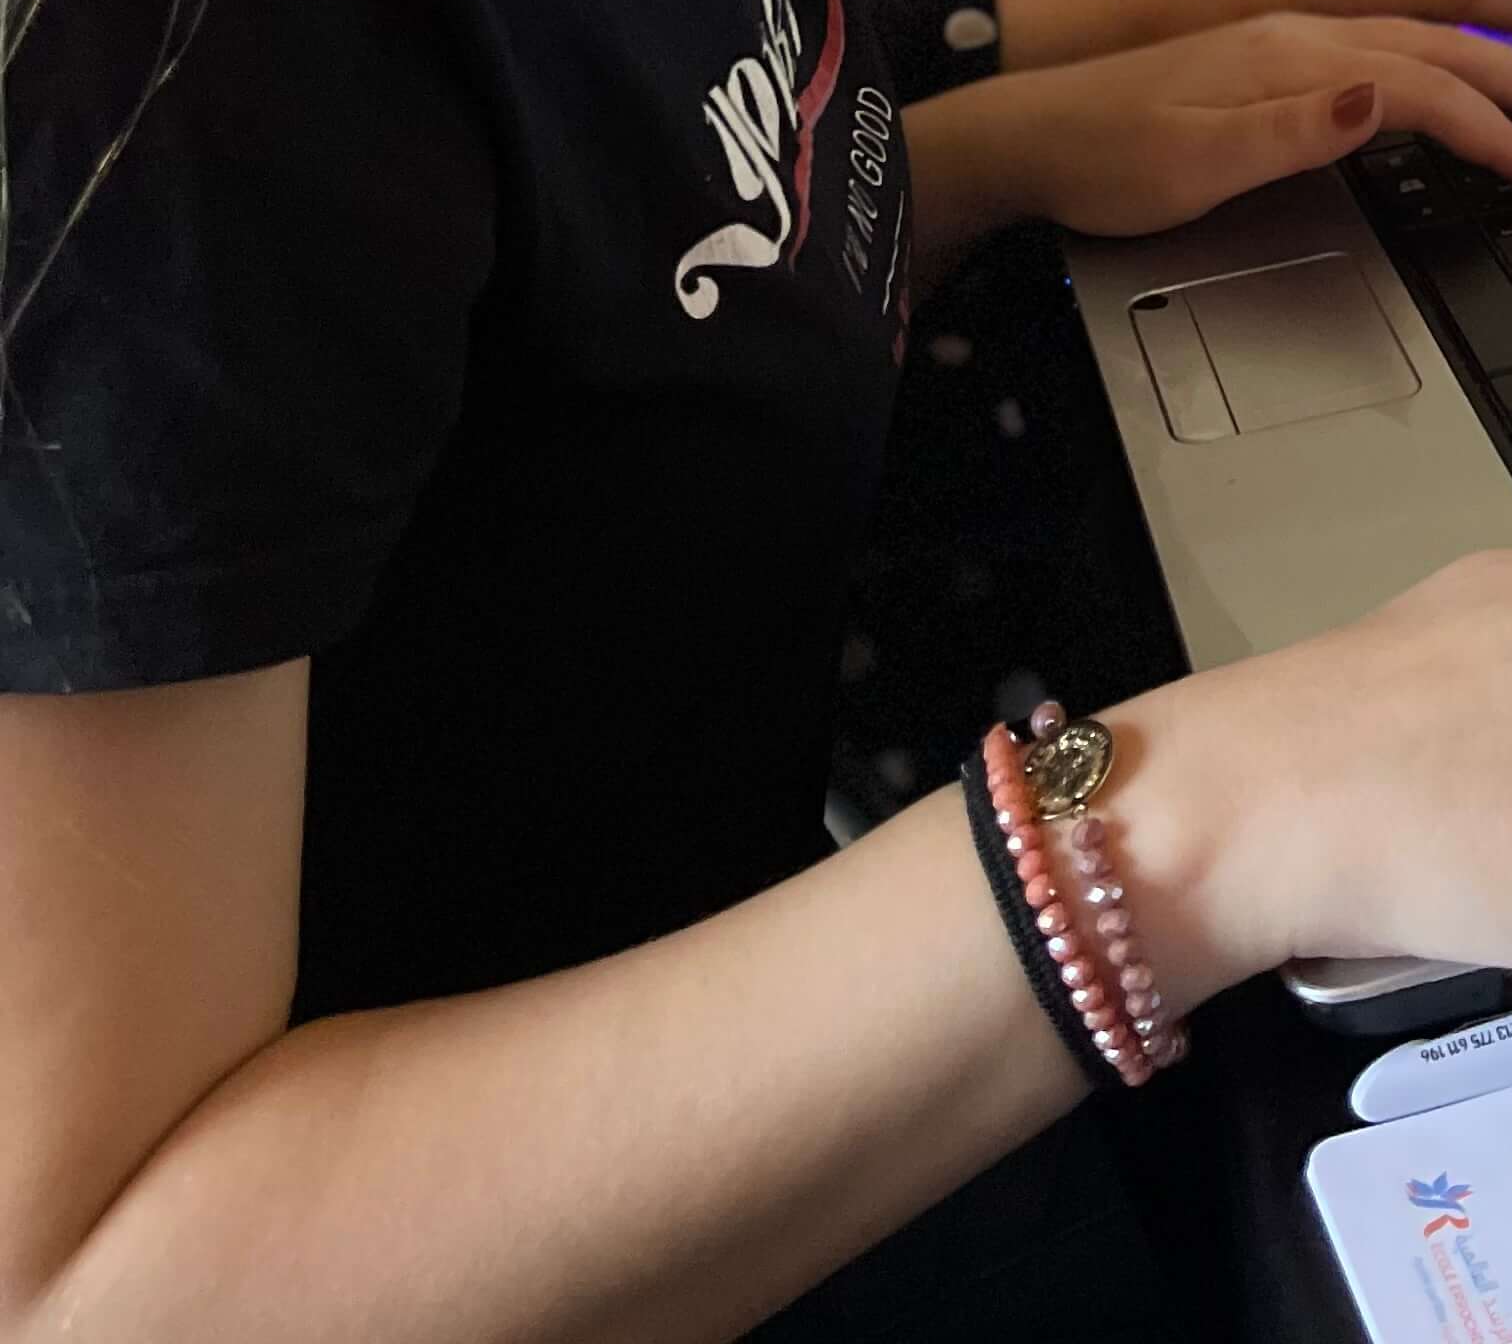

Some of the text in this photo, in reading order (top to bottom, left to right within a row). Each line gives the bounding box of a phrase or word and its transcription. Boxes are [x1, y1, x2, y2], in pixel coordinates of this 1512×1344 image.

[848, 85, 894, 187] GOOD
[1446, 1037, 1468, 1056] 611
[1470, 1029, 1495, 1049] 775
[1420, 1043, 1445, 1063] 196
